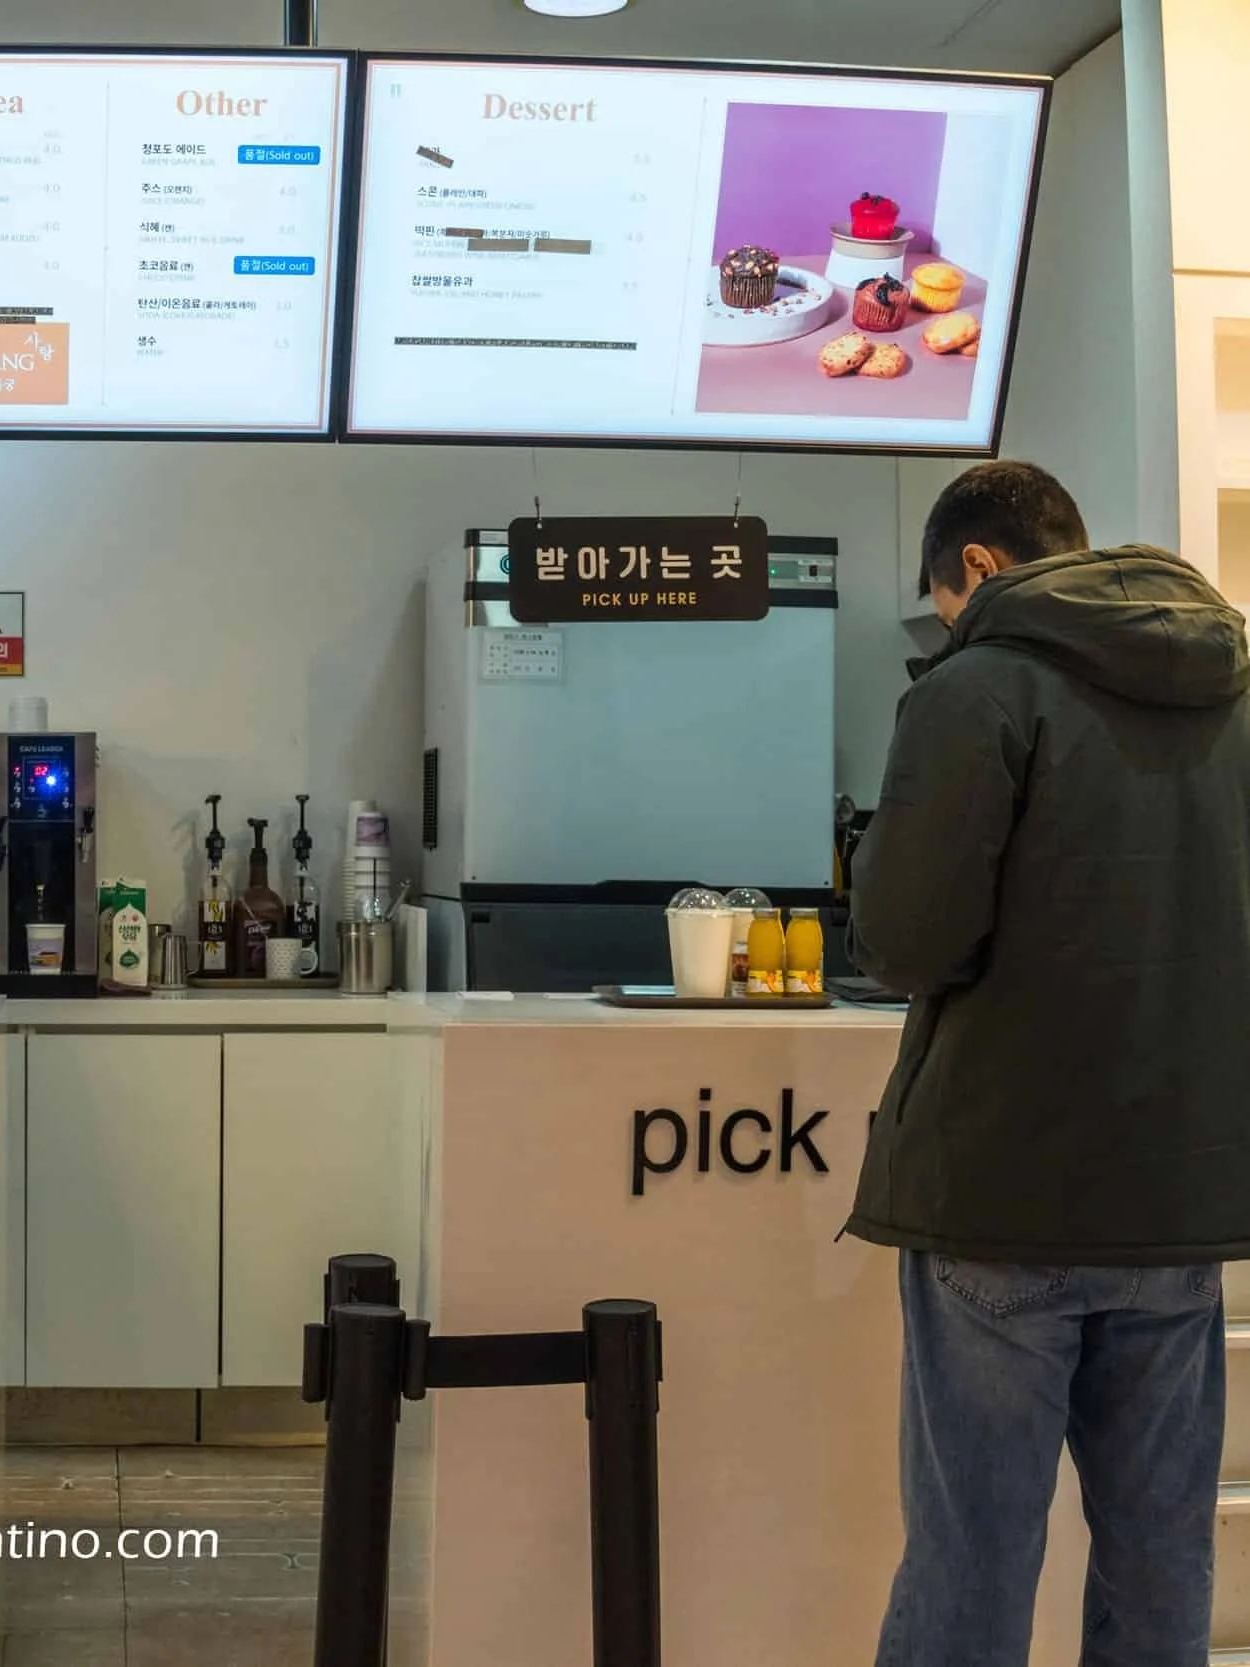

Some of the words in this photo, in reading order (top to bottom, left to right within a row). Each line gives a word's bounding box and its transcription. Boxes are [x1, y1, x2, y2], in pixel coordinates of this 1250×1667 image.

[176, 89, 268, 116] Other
[483, 93, 597, 122] Dessert
[176, 145, 206, 156] 에이드
[142, 183, 161, 194] 주스
[138, 259, 179, 272] 초코음료
[137, 297, 201, 310] 탄산/이온음료
[136, 335, 157, 347] 생수
[536, 545, 693, 580] 받아가는
[710, 545, 742, 580] 곳
[582, 592, 622, 607] PICK
[630, 592, 648, 606] UP
[656, 591, 698, 605] HERE
[631, 1087, 831, 1196] pick
